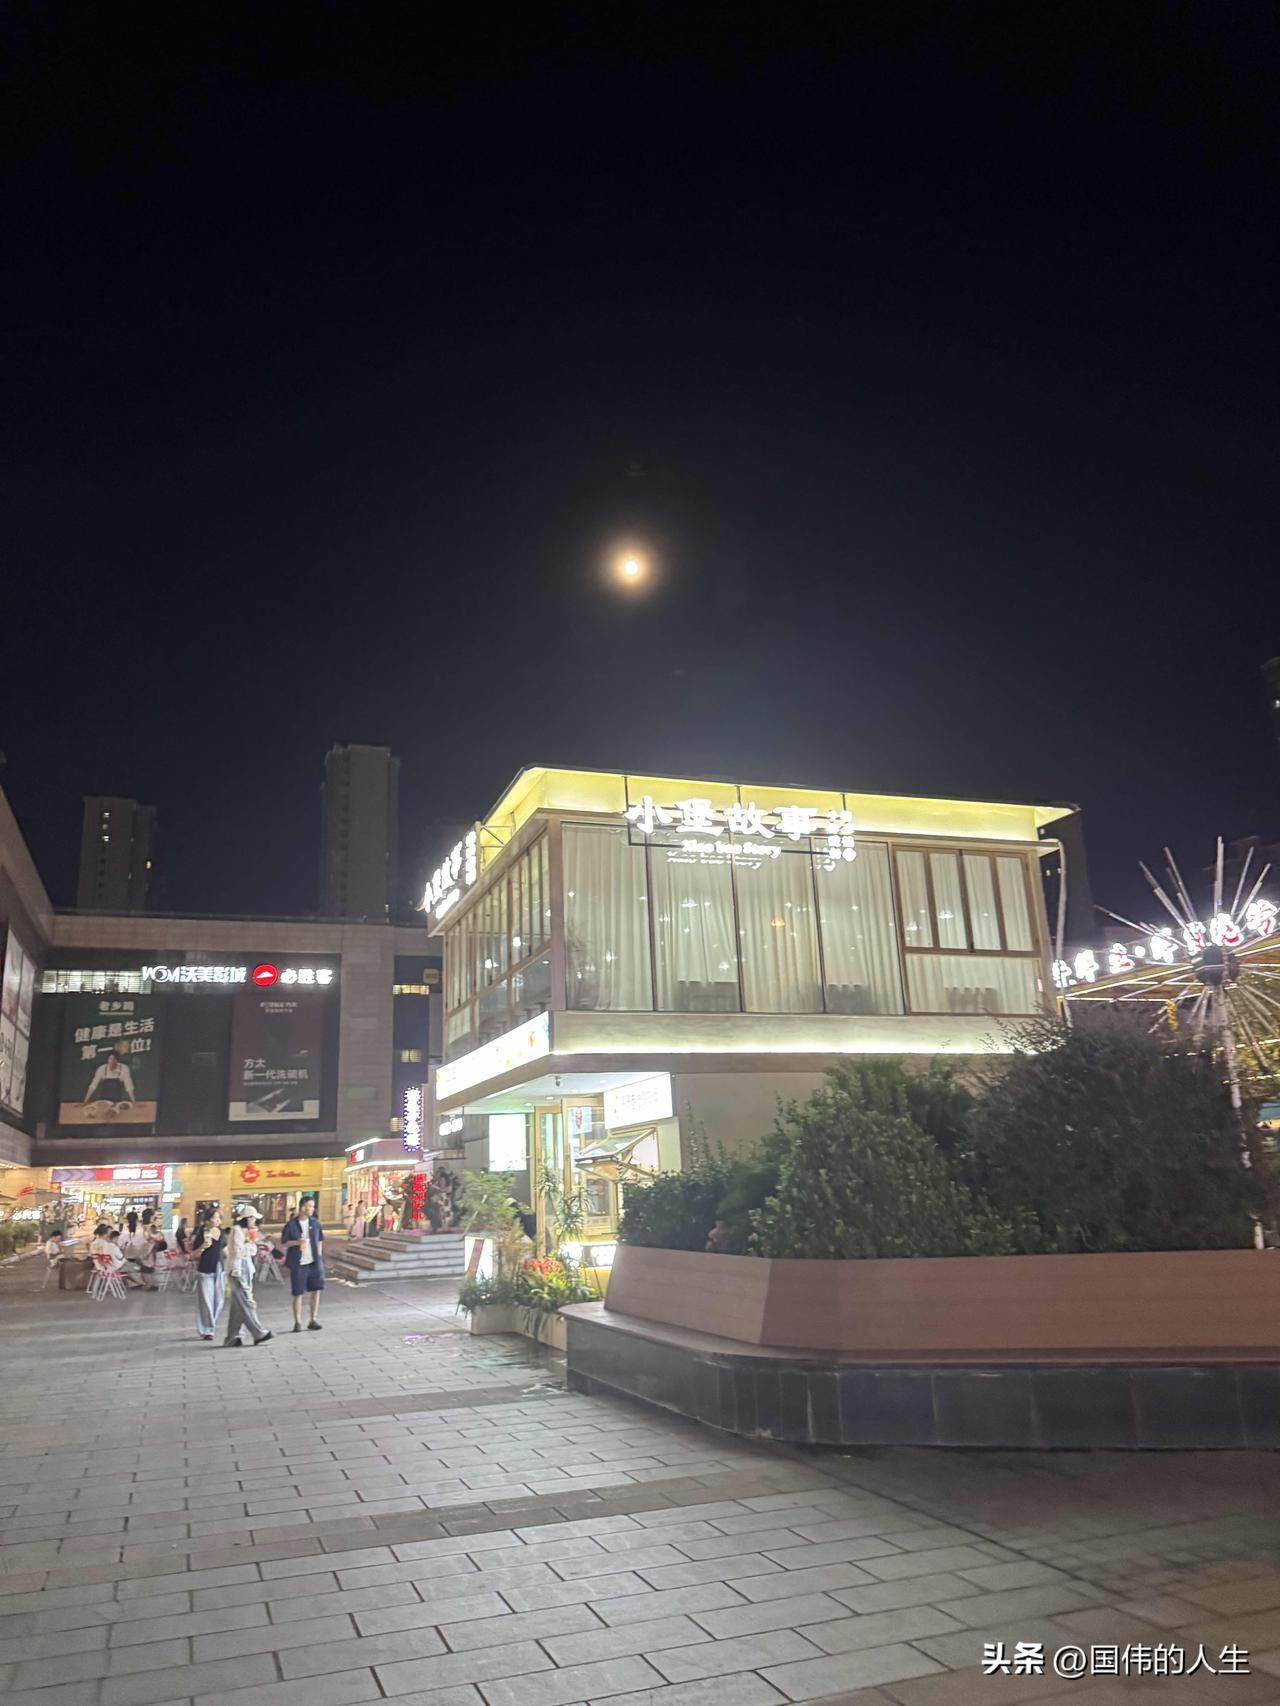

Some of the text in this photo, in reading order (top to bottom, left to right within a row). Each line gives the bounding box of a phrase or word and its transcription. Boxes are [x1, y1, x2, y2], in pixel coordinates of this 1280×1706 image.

[280, 968, 333, 985] 必胜客
[74, 1017, 155, 1043] 健康是生活
